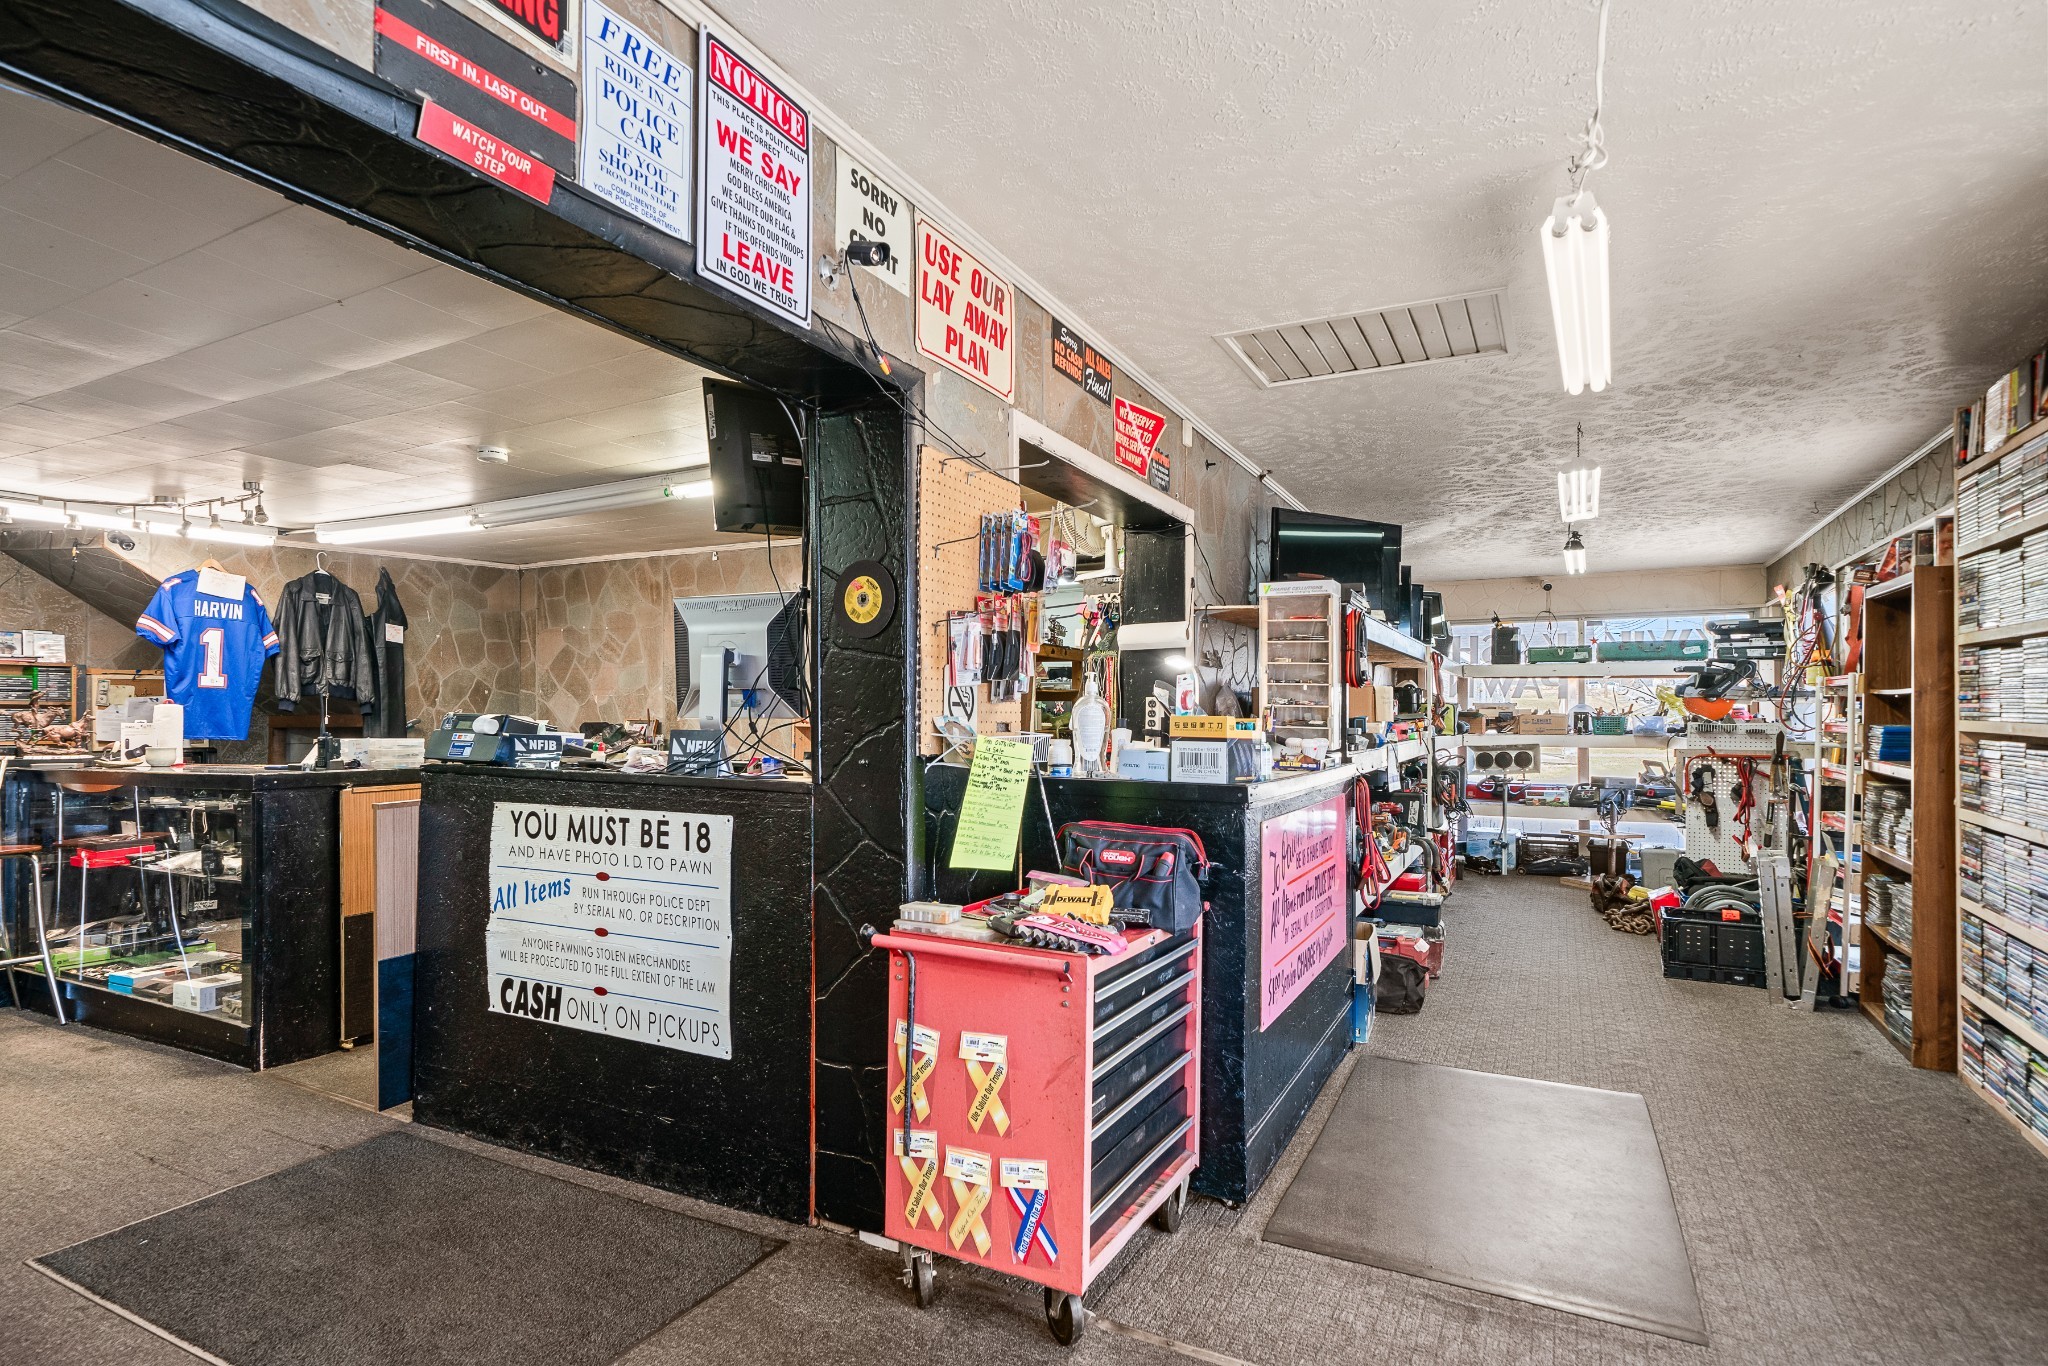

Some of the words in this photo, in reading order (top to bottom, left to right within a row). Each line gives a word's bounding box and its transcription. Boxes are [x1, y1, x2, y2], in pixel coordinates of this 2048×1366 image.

[598, 14, 681, 93] FREE
[416, 35, 460, 70] FIRST
[462, 62, 481, 84] IN.
[484, 75, 518, 104] LAST
[520, 97, 548, 122] OUT.
[604, 54, 644, 93] RIDE
[649, 85, 664, 107] IN
[668, 101, 677, 116] A
[713, 47, 803, 143] NOTICE
[602, 78, 679, 145] POLICE
[712, 90, 730, 109] THIS
[732, 106, 755, 127] PLACE
[756, 122, 763, 134] IS
[765, 129, 805, 165] POLITICALLY
[452, 121, 496, 154] WATCH
[501, 148, 531, 174] YOUR
[620, 117, 663, 159] CAR
[716, 118, 753, 166] WE
[761, 152, 801, 196] SAY
[741, 125, 781, 158] INCORRECT
[474, 151, 506, 175] STEP
[599, 148, 680, 204] SHOPLIFT
[617, 142, 633, 159] IF
[636, 154, 668, 184] YOU
[729, 157, 753, 181] MERRY
[754, 174, 791, 205] CHRISTMAS
[593, 182, 613, 197] YOUR
[615, 194, 639, 213] POLICE
[641, 208, 681, 234] DEPARTMENT
[600, 164, 627, 185] FROM
[629, 179, 648, 197] THIS
[650, 194, 677, 214] STORE
[611, 183, 656, 214] COMPLIMENTS
[659, 210, 667, 219] OF
[727, 172, 742, 189] GOD
[743, 182, 763, 203] BLESS
[764, 196, 792, 222] AMERICA
[851, 168, 898, 217] SORRY
[711, 195, 728, 213] GIVE
[729, 204, 756, 230] THANKS
[757, 221, 765, 236] TO
[766, 228, 780, 245] OUR
[780, 236, 804, 260] TROOPS
[721, 184, 733, 200] WE
[734, 193, 759, 217] SALUTE
[760, 209, 774, 226] OUR
[775, 216, 790, 237] FLAG
[791, 228, 796, 240] &
[863, 206, 885, 237] NO
[722, 232, 794, 294] LEAVE
[725, 220, 732, 233] IF
[733, 224, 749, 242] THIS
[750, 235, 779, 260] OFFENDS
[779, 251, 792, 267] YOU
[716, 258, 727, 273] IN
[730, 267, 750, 285] GOD
[753, 279, 767, 295] WE
[770, 287, 798, 311] TRUST
[925, 232, 962, 286] USE
[971, 268, 1005, 317] OUR
[922, 270, 954, 317] LAY
[963, 301, 1008, 352] AWAY
[945, 324, 989, 377] PLAN
[1054, 339, 1065, 356] NO
[1066, 348, 1083, 369] CASH
[1060, 327, 1078, 353] Sorry
[1054, 353, 1082, 381] REFUNDS
[1085, 347, 1095, 369] ALL
[1095, 355, 1111, 381] SALES
[1142, 429, 1152, 444] TO
[194, 600, 243, 620] HARVIN
[198, 628, 228, 689] 1
[529, 740, 557, 751] NFIB
[510, 810, 557, 840] YOU
[567, 814, 630, 846] MUST
[640, 818, 669, 849] BE
[683, 821, 711, 853] 18
[509, 845, 534, 858] AND
[539, 847, 571, 862] HAVE
[576, 852, 619, 867] PHOTO
[624, 855, 643, 868] I.D.
[647, 856, 665, 871] TO
[670, 858, 713, 875] PAWN
[1104, 854, 1131, 862] TOUGH
[493, 882, 517, 912] All
[524, 877, 571, 905] Items
[582, 886, 599, 899] RUN
[603, 888, 646, 905] THROUGH
[649, 895, 684, 910] POLICE
[687, 898, 710, 913] DEPT
[573, 903, 584, 914] BY
[587, 904, 616, 919] SERIAL
[619, 909, 636, 922] NO.
[640, 911, 653, 923] OR
[656, 913, 720, 932] DESCRIPTION
[500, 949, 517, 962] WILL
[519, 952, 529, 964] BE
[530, 954, 579, 972] PROSECUTED
[581, 961, 592, 974] TO
[595, 963, 609, 977] THE
[611, 965, 629, 980] FULL
[632, 969, 661, 986] EXTENT
[663, 972, 676, 987] OF
[678, 975, 694, 991] THE
[697, 978, 716, 994] LAW
[521, 937, 553, 952] ANYONE
[556, 942, 594, 958] PAWNING
[596, 947, 626, 962] STOLEN
[628, 951, 691, 973] MERCHANDISE
[500, 977, 563, 1022] CASH
[567, 998, 608, 1025] ONLY
[615, 1006, 641, 1032] ON
[649, 1012, 720, 1047] PICKUPS
[893, 1095, 902, 1105] We
[918, 1057, 933, 1075] Troops
[985, 1082, 995, 1095] Our
[989, 1064, 1004, 1084] Troops
[970, 1112, 978, 1123] We
[976, 1094, 990, 1112] Salute
[919, 1178, 929, 1191] Our
[923, 1160, 936, 1180] Troops
[908, 1208, 915, 1219] We
[913, 1190, 924, 1208] Salute
[1030, 1206, 1041, 1222] the
[1035, 1192, 1046, 1207] USA
[1019, 1240, 1029, 1254] God
[1023, 1221, 1036, 1241] Bless
